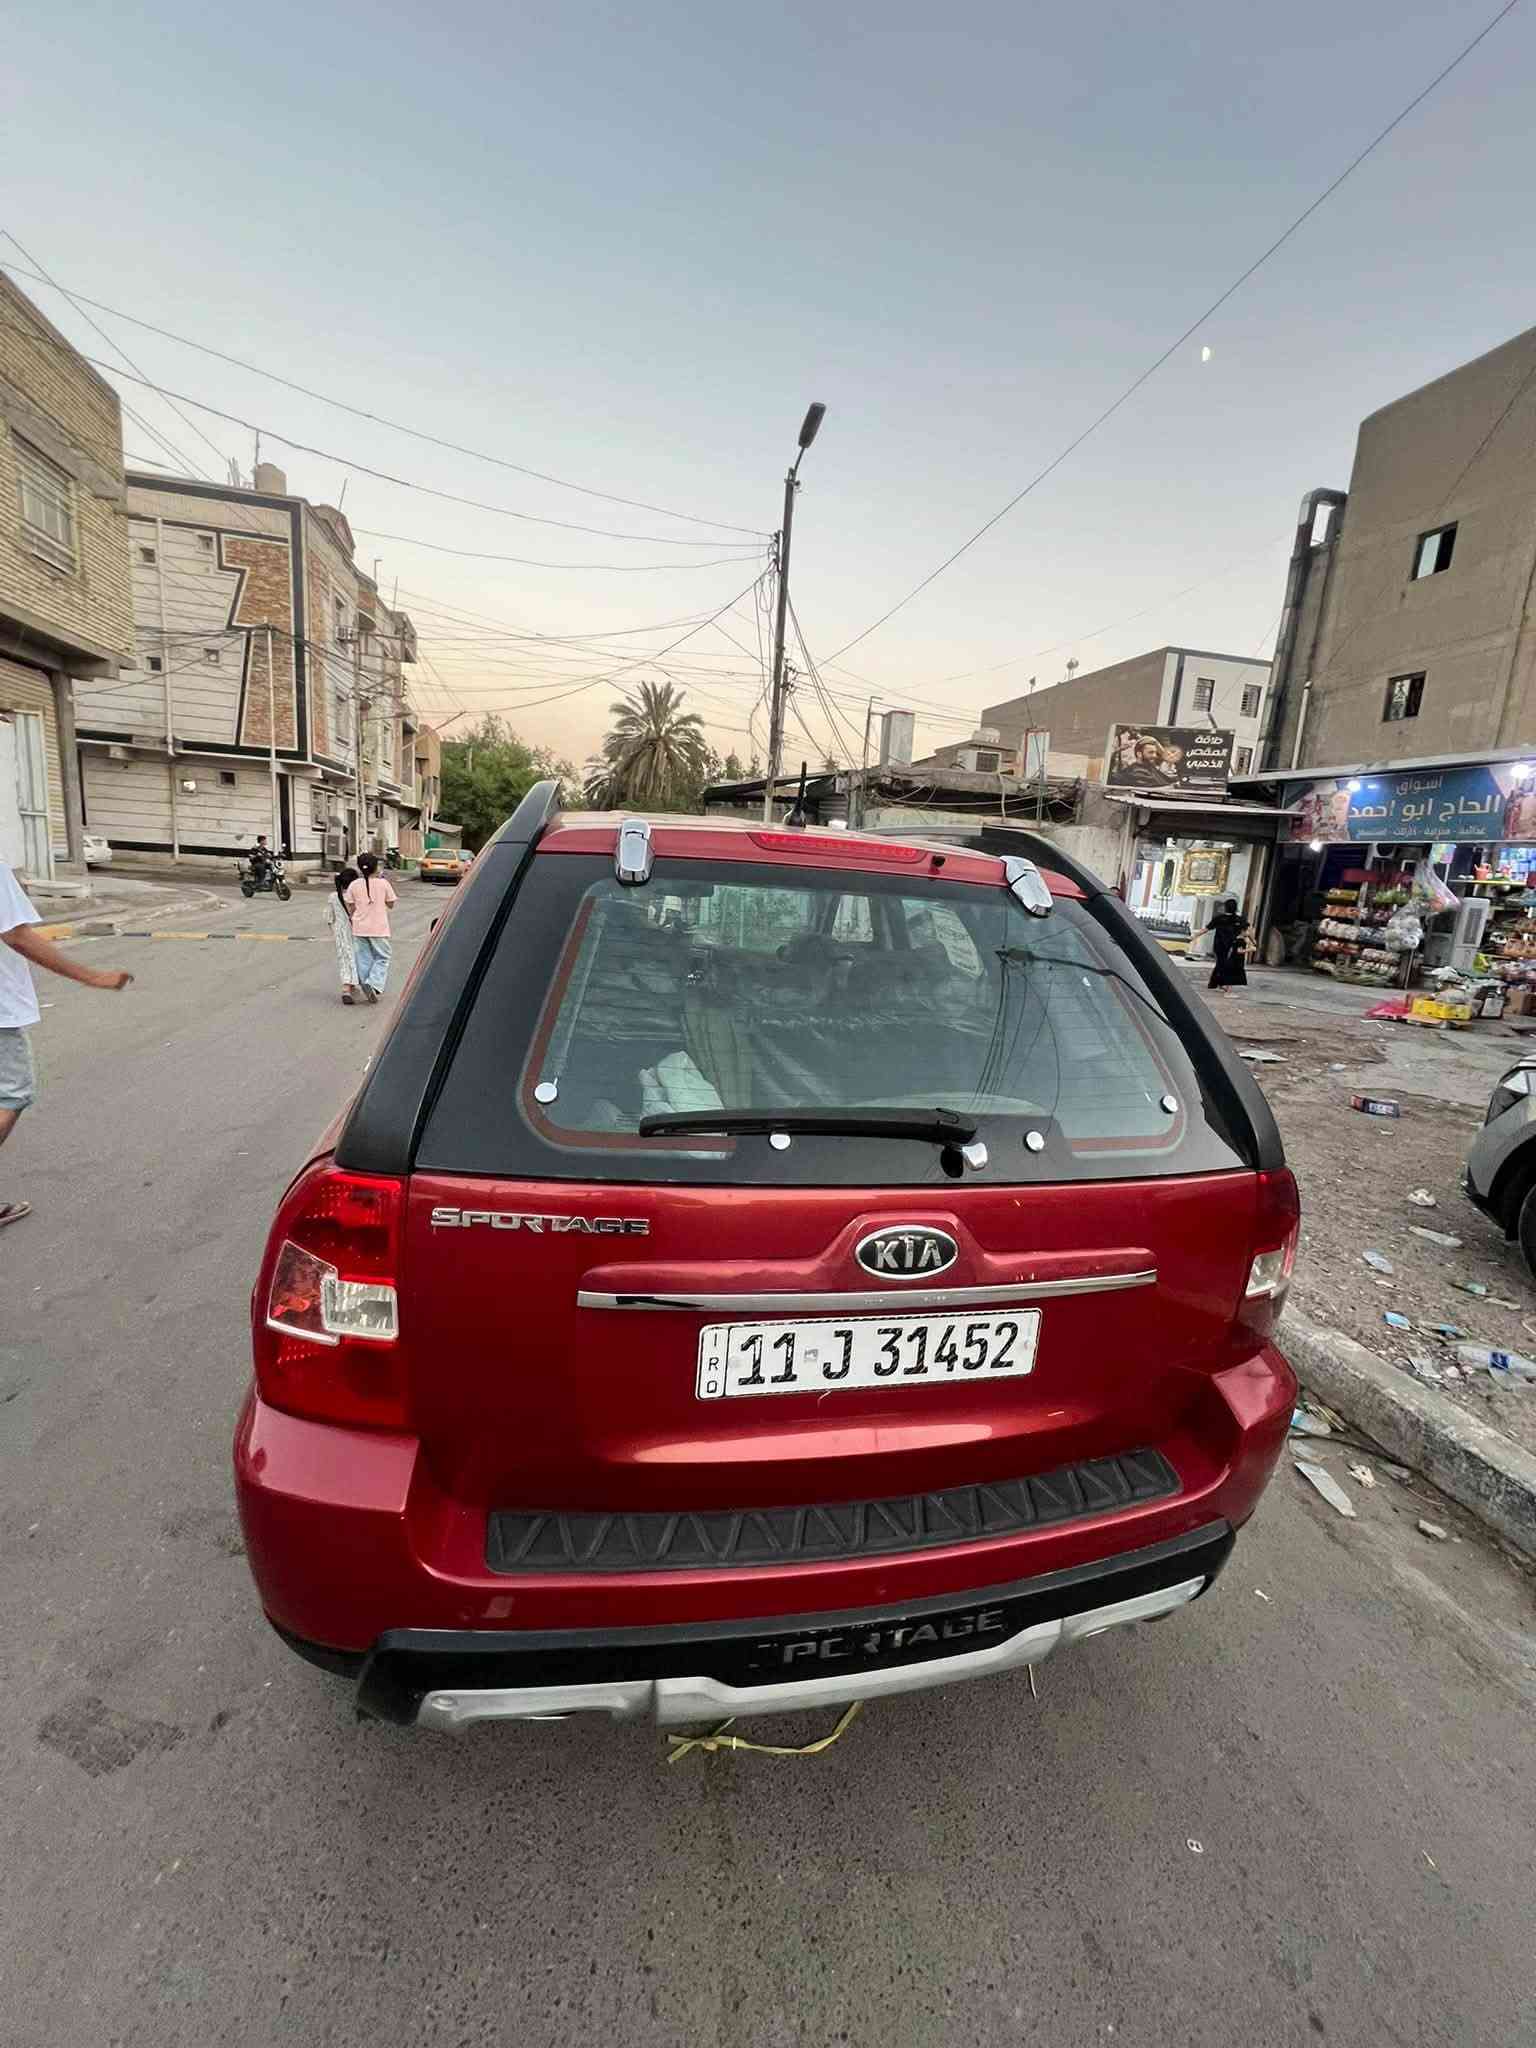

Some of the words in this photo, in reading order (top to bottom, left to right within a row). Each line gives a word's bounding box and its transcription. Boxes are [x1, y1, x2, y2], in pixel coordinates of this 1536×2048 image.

[1186, 759, 1224, 770] الذهبي
[1348, 799, 1396, 818] احمد
[1401, 798, 1433, 822] ابو
[1439, 793, 1501, 822] الحاج
[431, 1207, 650, 1235] SPORTAGE
[874, 1236, 943, 1270] KIA
[738, 1332, 798, 1386] 11
[823, 1329, 854, 1380] J
[873, 1321, 1020, 1377] 31452
